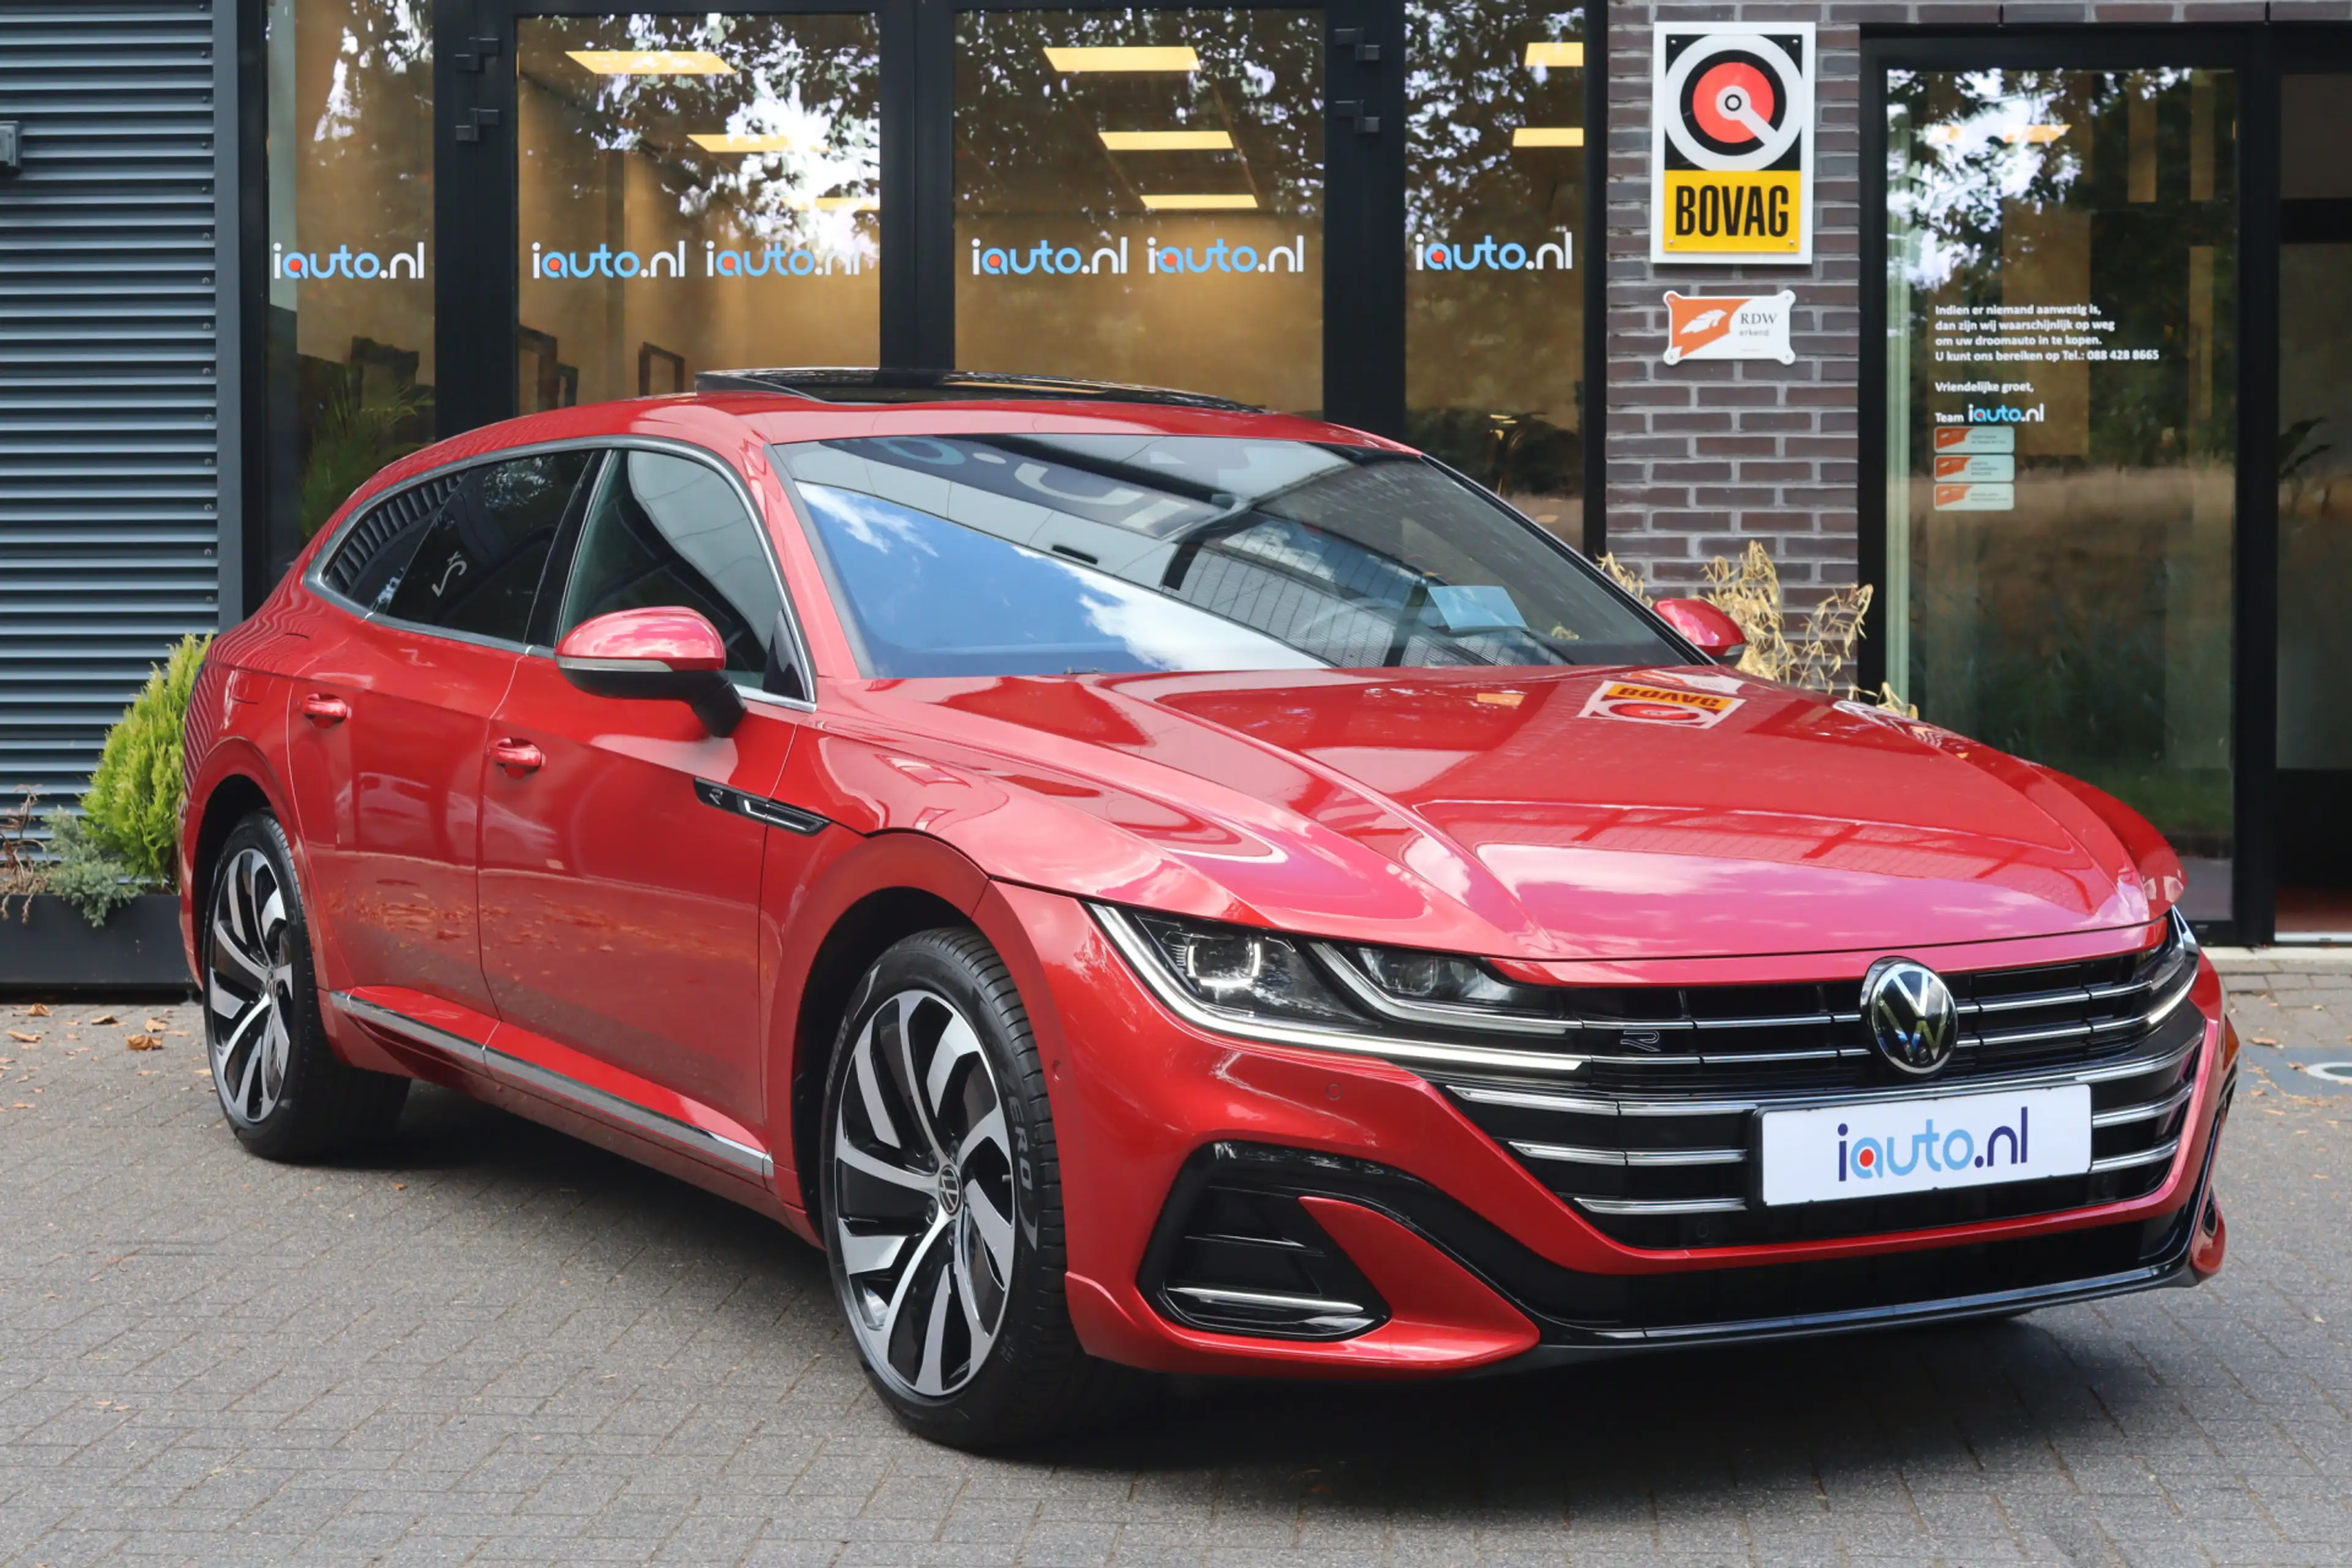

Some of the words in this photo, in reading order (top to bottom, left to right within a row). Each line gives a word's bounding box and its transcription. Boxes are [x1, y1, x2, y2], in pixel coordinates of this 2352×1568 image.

[1675, 185, 1789, 237] BOVAG
[273, 241, 424, 279] iauto.nl
[532, 240, 685, 279] iauto.nl
[706, 240, 860, 277] iauto.nl
[972, 236, 1128, 274] iauto.nl
[1147, 235, 1304, 273] iauto.nl
[1415, 232, 1573, 271] iauto.nl
[1740, 312, 1778, 325] RDW
[1935, 304, 1970, 315] Indien
[1972, 306, 1983, 315] er
[1986, 304, 2034, 315] niemand
[2036, 304, 2087, 317] aanwezig
[2089, 304, 2101, 315] is,
[1739, 328, 1770, 337] erkend
[1935, 320, 1956, 331] dan
[1959, 320, 1977, 333] zijn
[1980, 320, 1997, 333] wij
[1998, 319, 2073, 332] waarschijnlijk
[2075, 321, 2090, 331] op
[2092, 321, 2115, 331] weg
[1935, 337, 1953, 346] om
[1955, 337, 1972, 346] uw
[1975, 335, 2036, 346] droomauto
[2038, 335, 2049, 345] in
[2052, 336, 2063, 345] te
[2065, 334, 2102, 347] kopen.
[1935, 351, 1944, 361] U
[1946, 350, 1972, 361] kunt
[1973, 353, 1994, 361] ons
[1996, 350, 2043, 361] bereiken
[2045, 352, 2060, 363] op
[2087, 349, 2108, 360] 088
[2109, 349, 2130, 360] 428
[2132, 349, 2160, 360] 8665
[1934, 381, 2000, 394] Vriendelijke
[2001, 382, 2034, 394] groet,
[1934, 412, 1964, 423] Team
[1968, 403, 2045, 423] iauto.nl
[1838, 1106, 2028, 1182] iauto.nl
